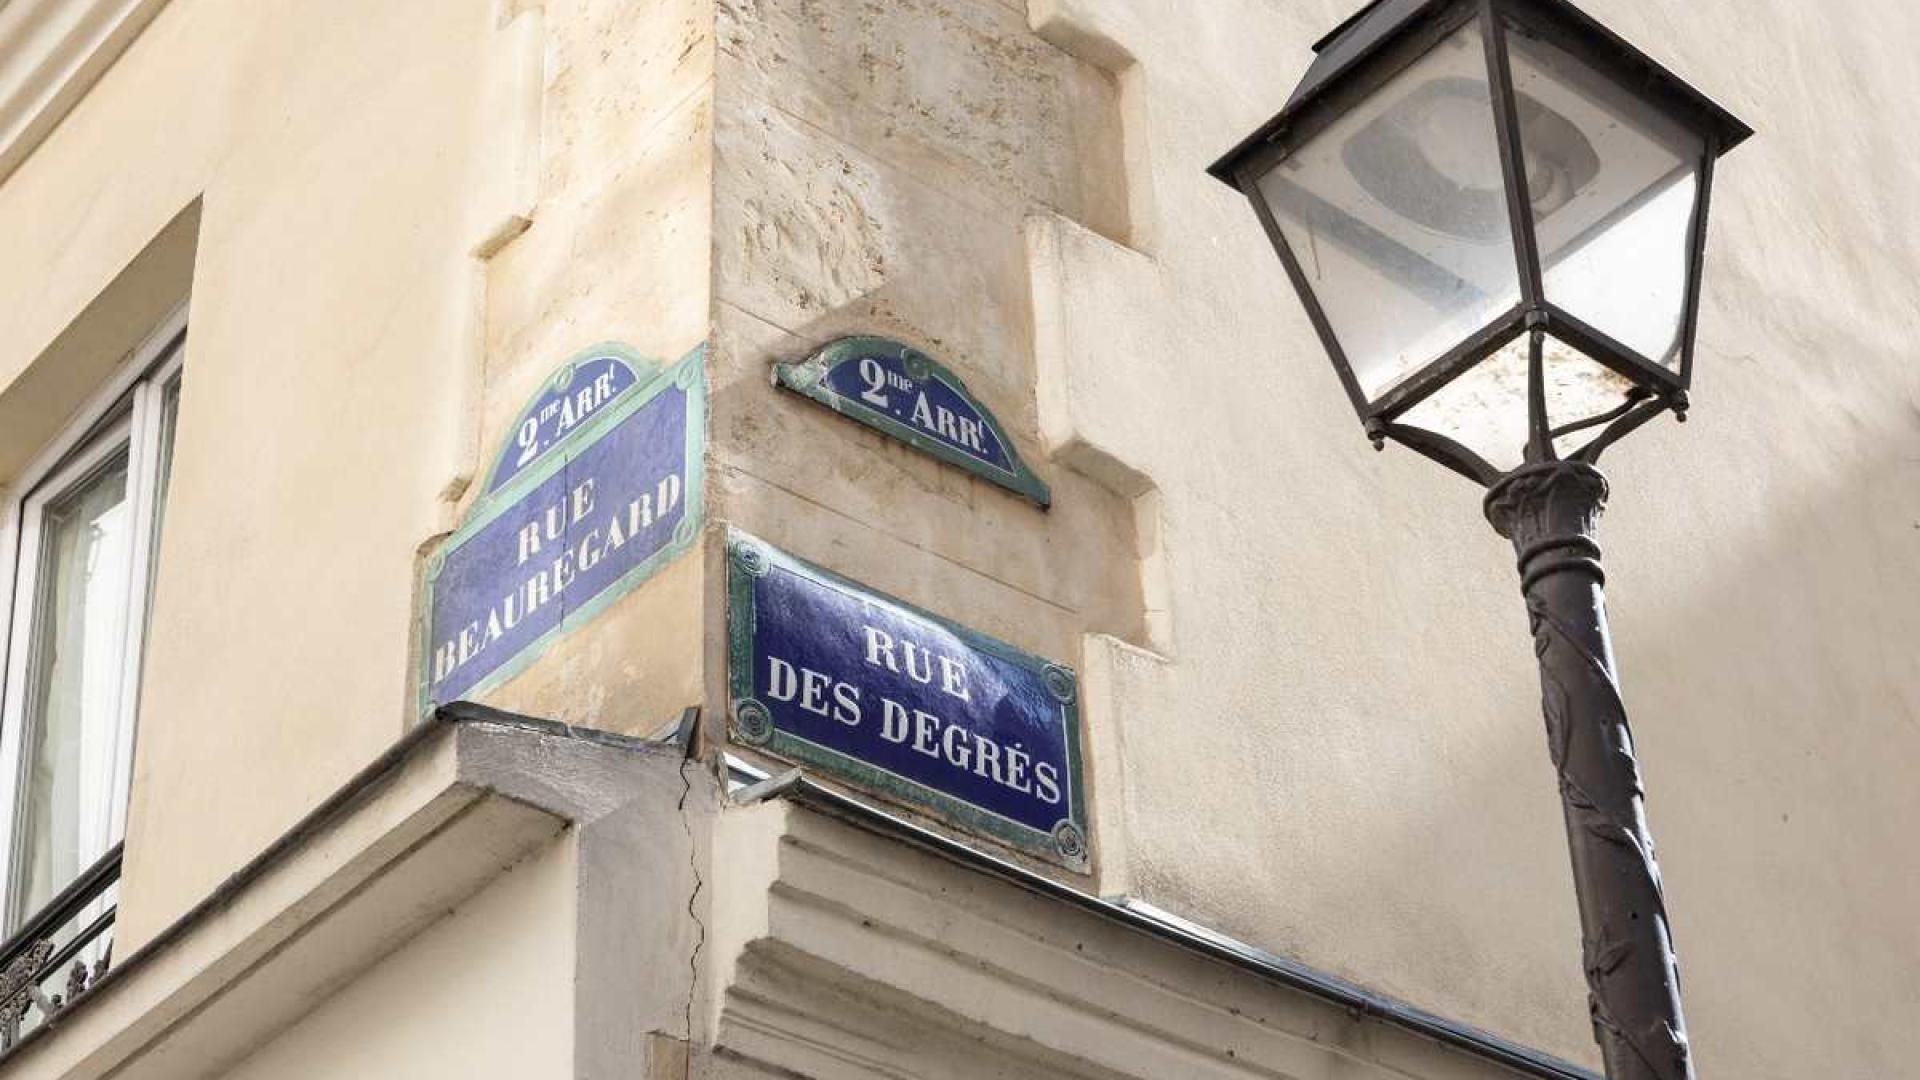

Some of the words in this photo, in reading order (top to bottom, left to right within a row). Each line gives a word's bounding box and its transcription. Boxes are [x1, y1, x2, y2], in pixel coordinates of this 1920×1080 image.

[434, 473, 681, 684] BEAUREGARD
[517, 478, 596, 566] RUE
[863, 625, 969, 701] RUE
[767, 655, 861, 726] DES
[881, 698, 1061, 804] DEGRÉS
